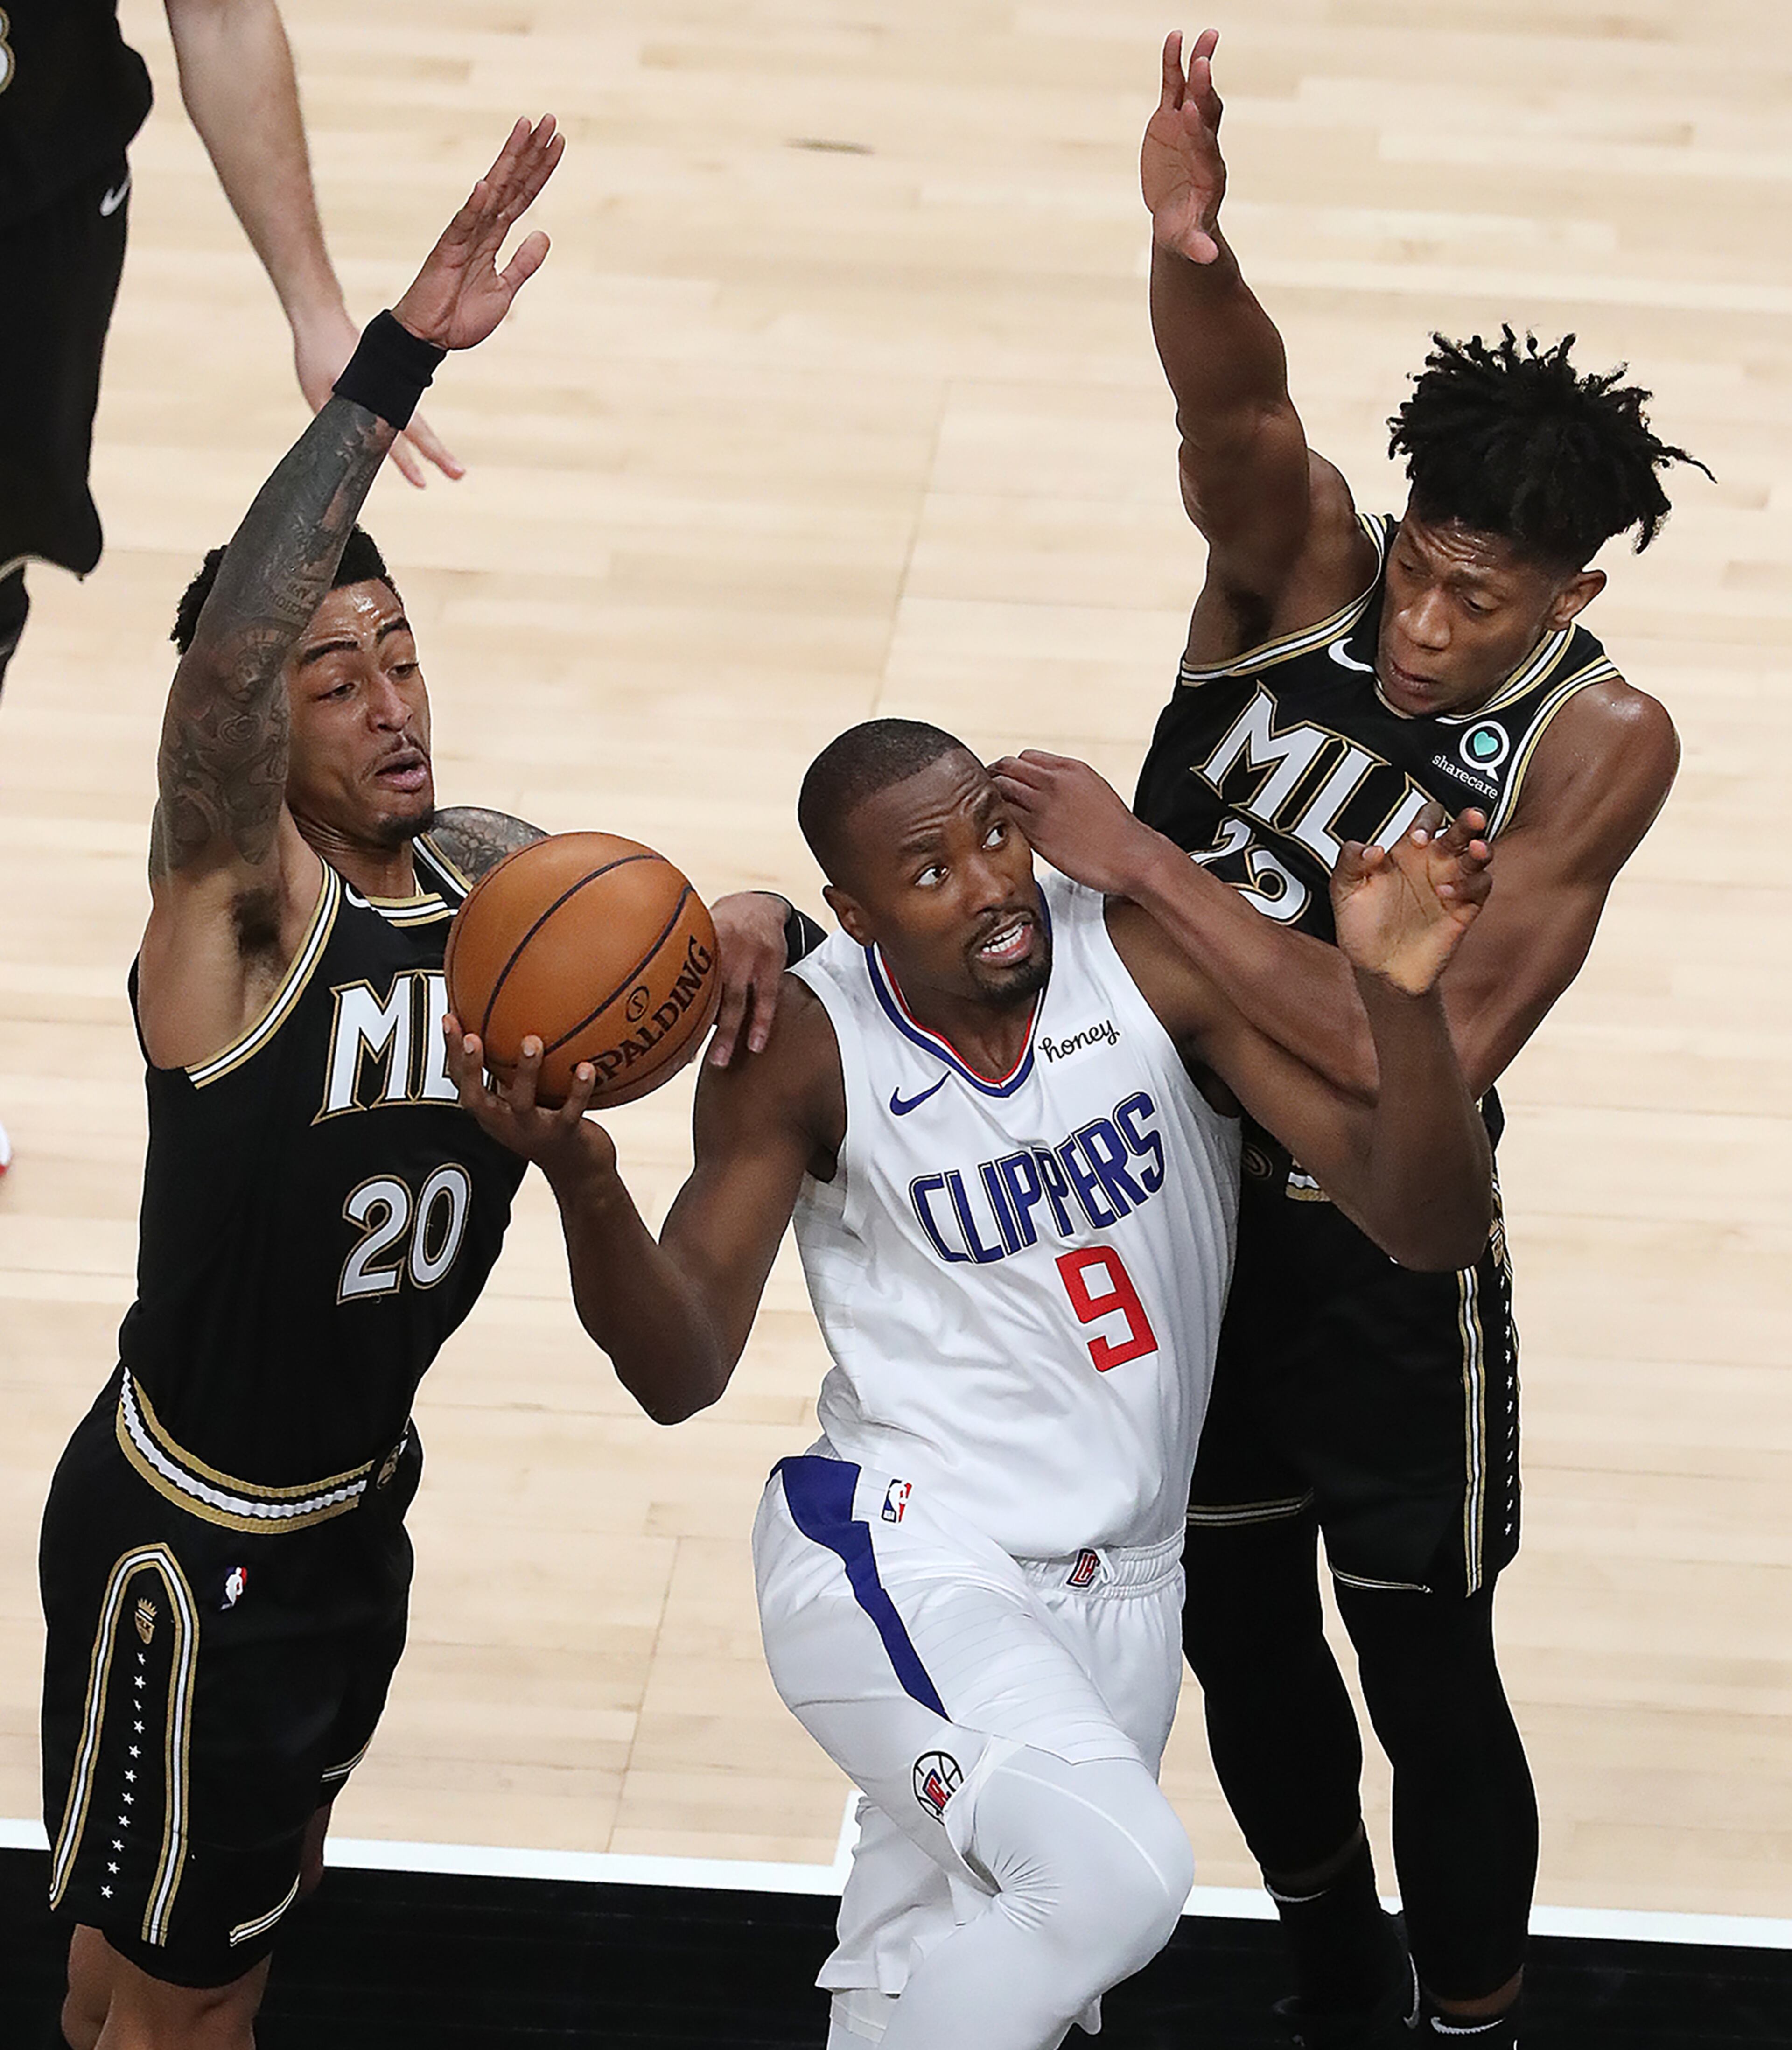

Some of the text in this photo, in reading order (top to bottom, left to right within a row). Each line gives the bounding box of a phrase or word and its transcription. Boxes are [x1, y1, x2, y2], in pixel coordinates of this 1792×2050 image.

[1189, 679, 1455, 876] ML
[1431, 755, 1498, 799] sharecare
[310, 968, 467, 1126] ML
[1038, 1020, 1120, 1063] honey
[336, 1162, 471, 1305] 20
[909, 1091, 1166, 1264] CLIPPERS
[1055, 1245, 1159, 1372] 9
